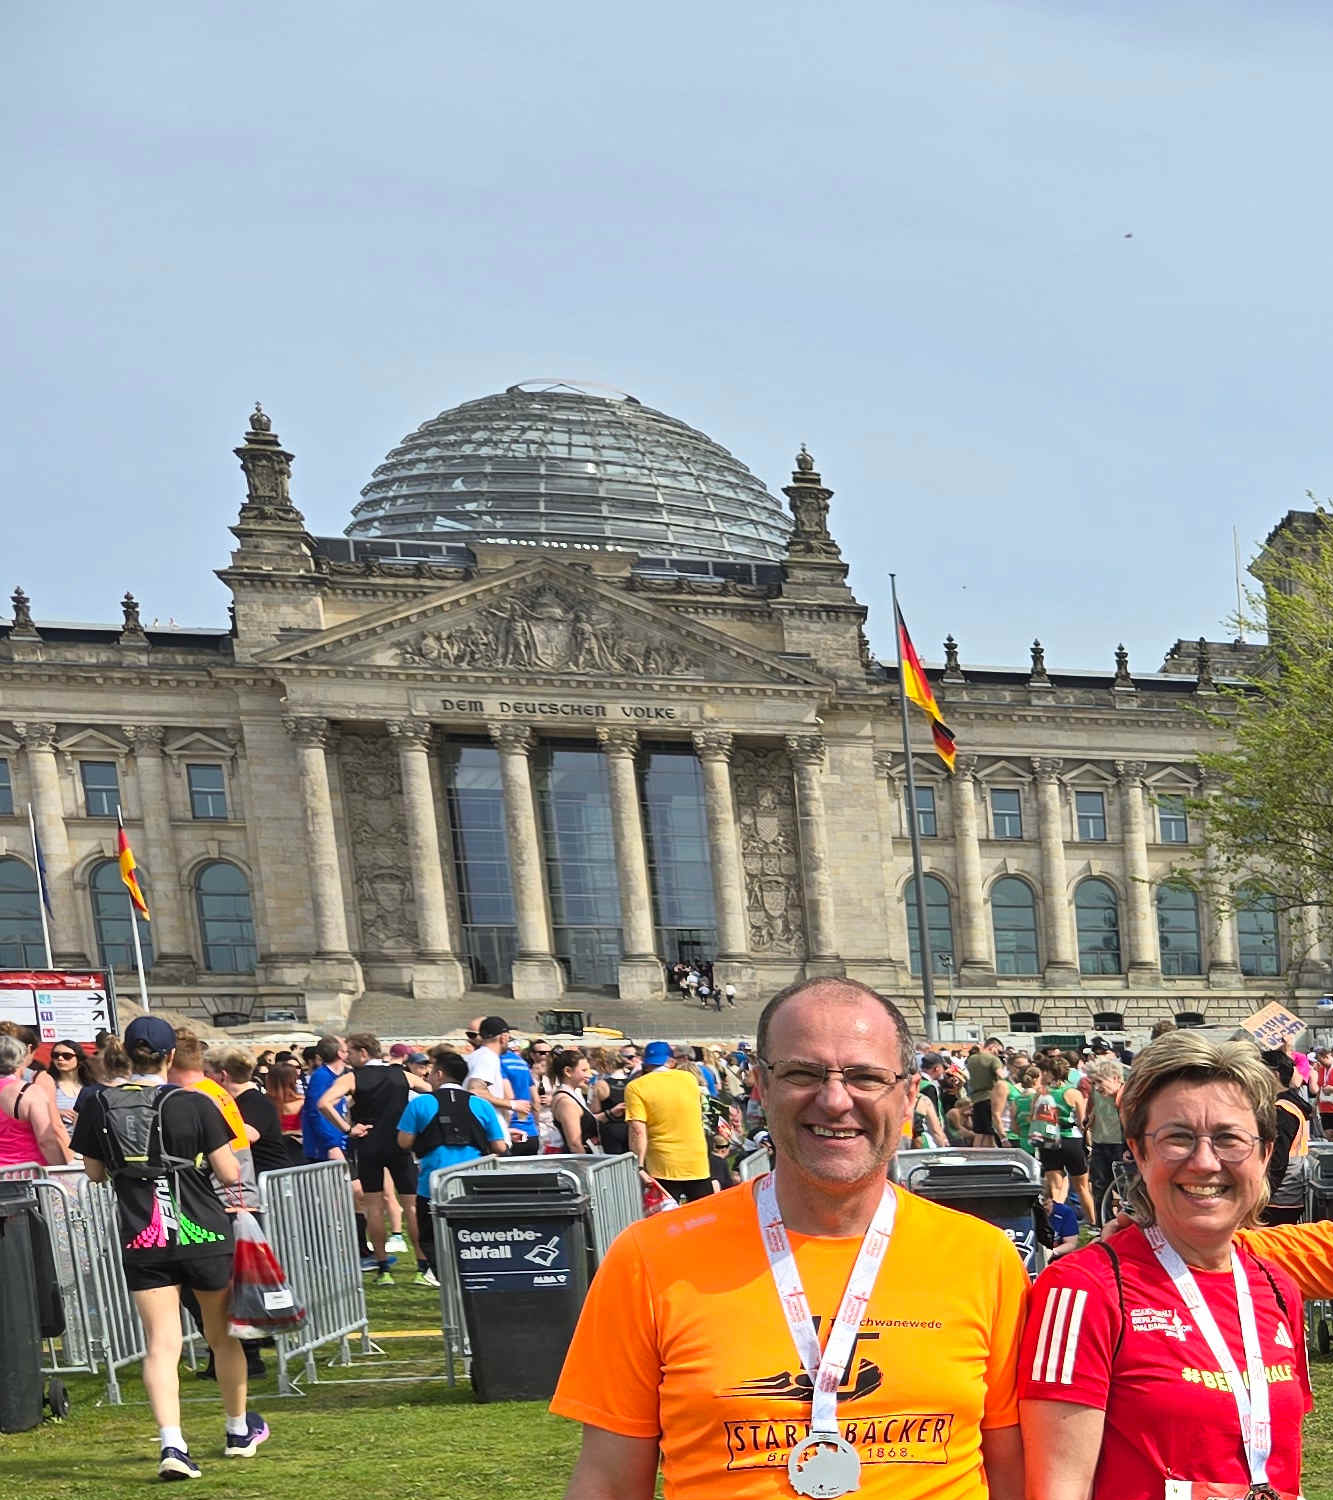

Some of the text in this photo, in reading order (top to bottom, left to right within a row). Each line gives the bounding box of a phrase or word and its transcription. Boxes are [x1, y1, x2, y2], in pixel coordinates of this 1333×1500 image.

[441, 699, 677, 719] DEM DEUTSCHEN VOLKE
[457, 1228, 543, 1242] Gewerbe-
[460, 1245, 512, 1259] abfall
[859, 1317, 943, 1329] chwanewede
